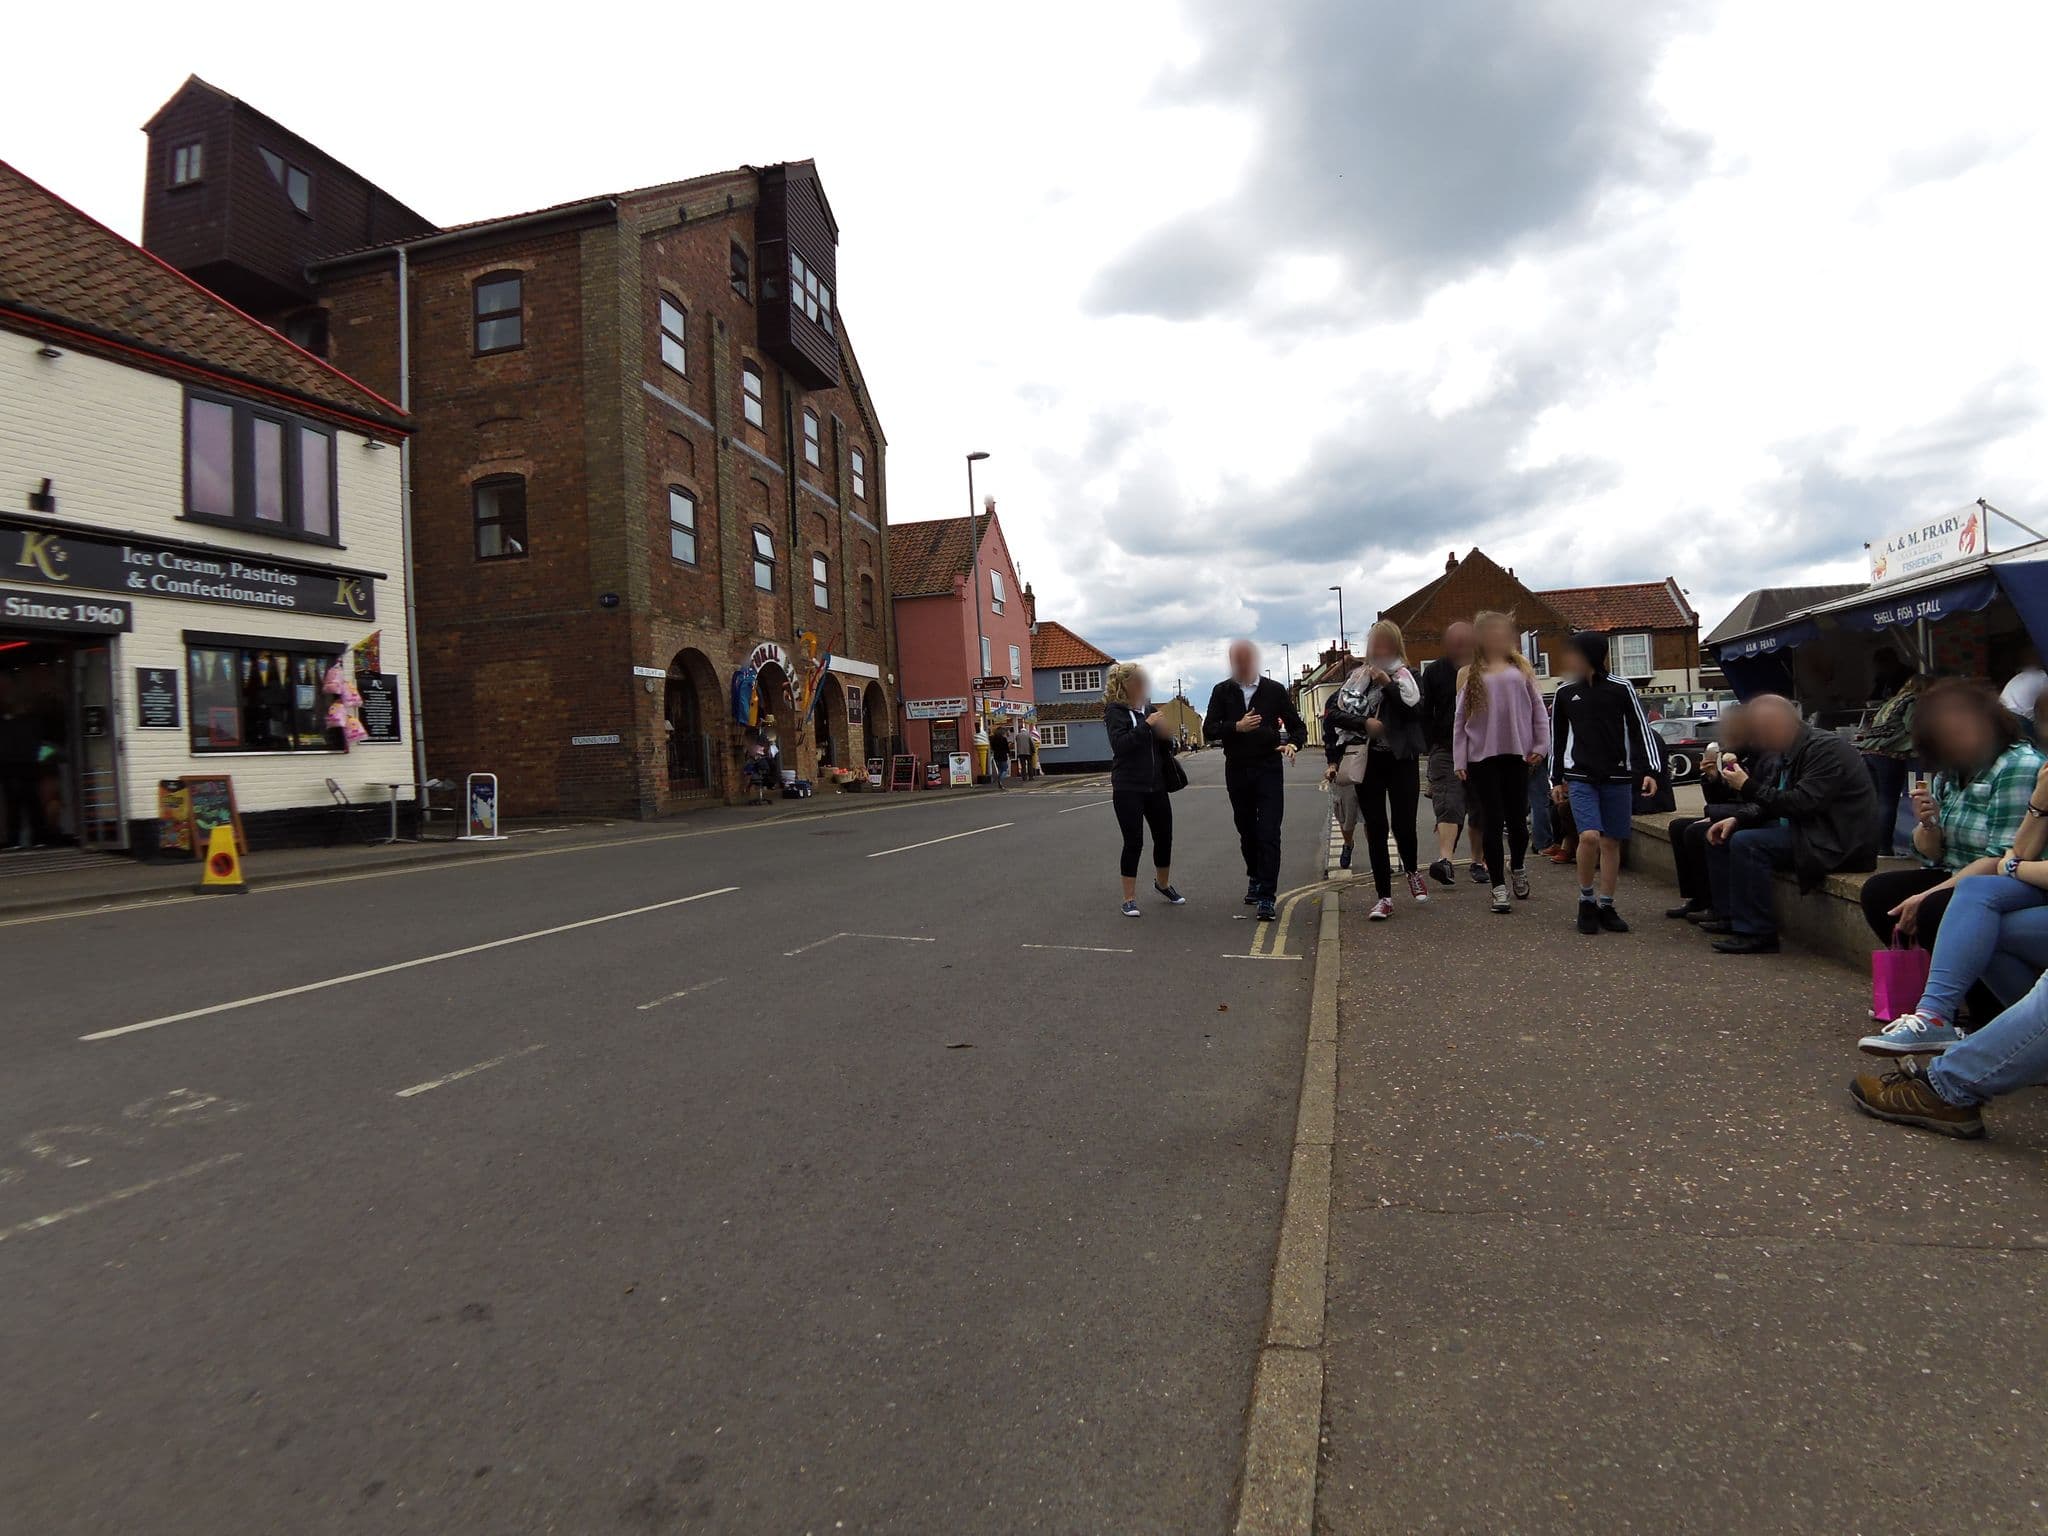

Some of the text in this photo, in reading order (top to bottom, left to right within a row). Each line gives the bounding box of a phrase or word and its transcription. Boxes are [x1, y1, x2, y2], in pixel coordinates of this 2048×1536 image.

[1897, 536, 1906, 550] &
[1922, 516, 1960, 541] FRARY
[16, 531, 70, 581] K's
[122, 546, 298, 586] Ice Cream, Pastries
[127, 571, 296, 607] & Confectionaries
[333, 577, 367, 615] K's
[5, 597, 124, 625] Since 1960
[1873, 599, 1941, 624] SHELL FISH STALL
[1636, 686, 1675, 696] REAM
